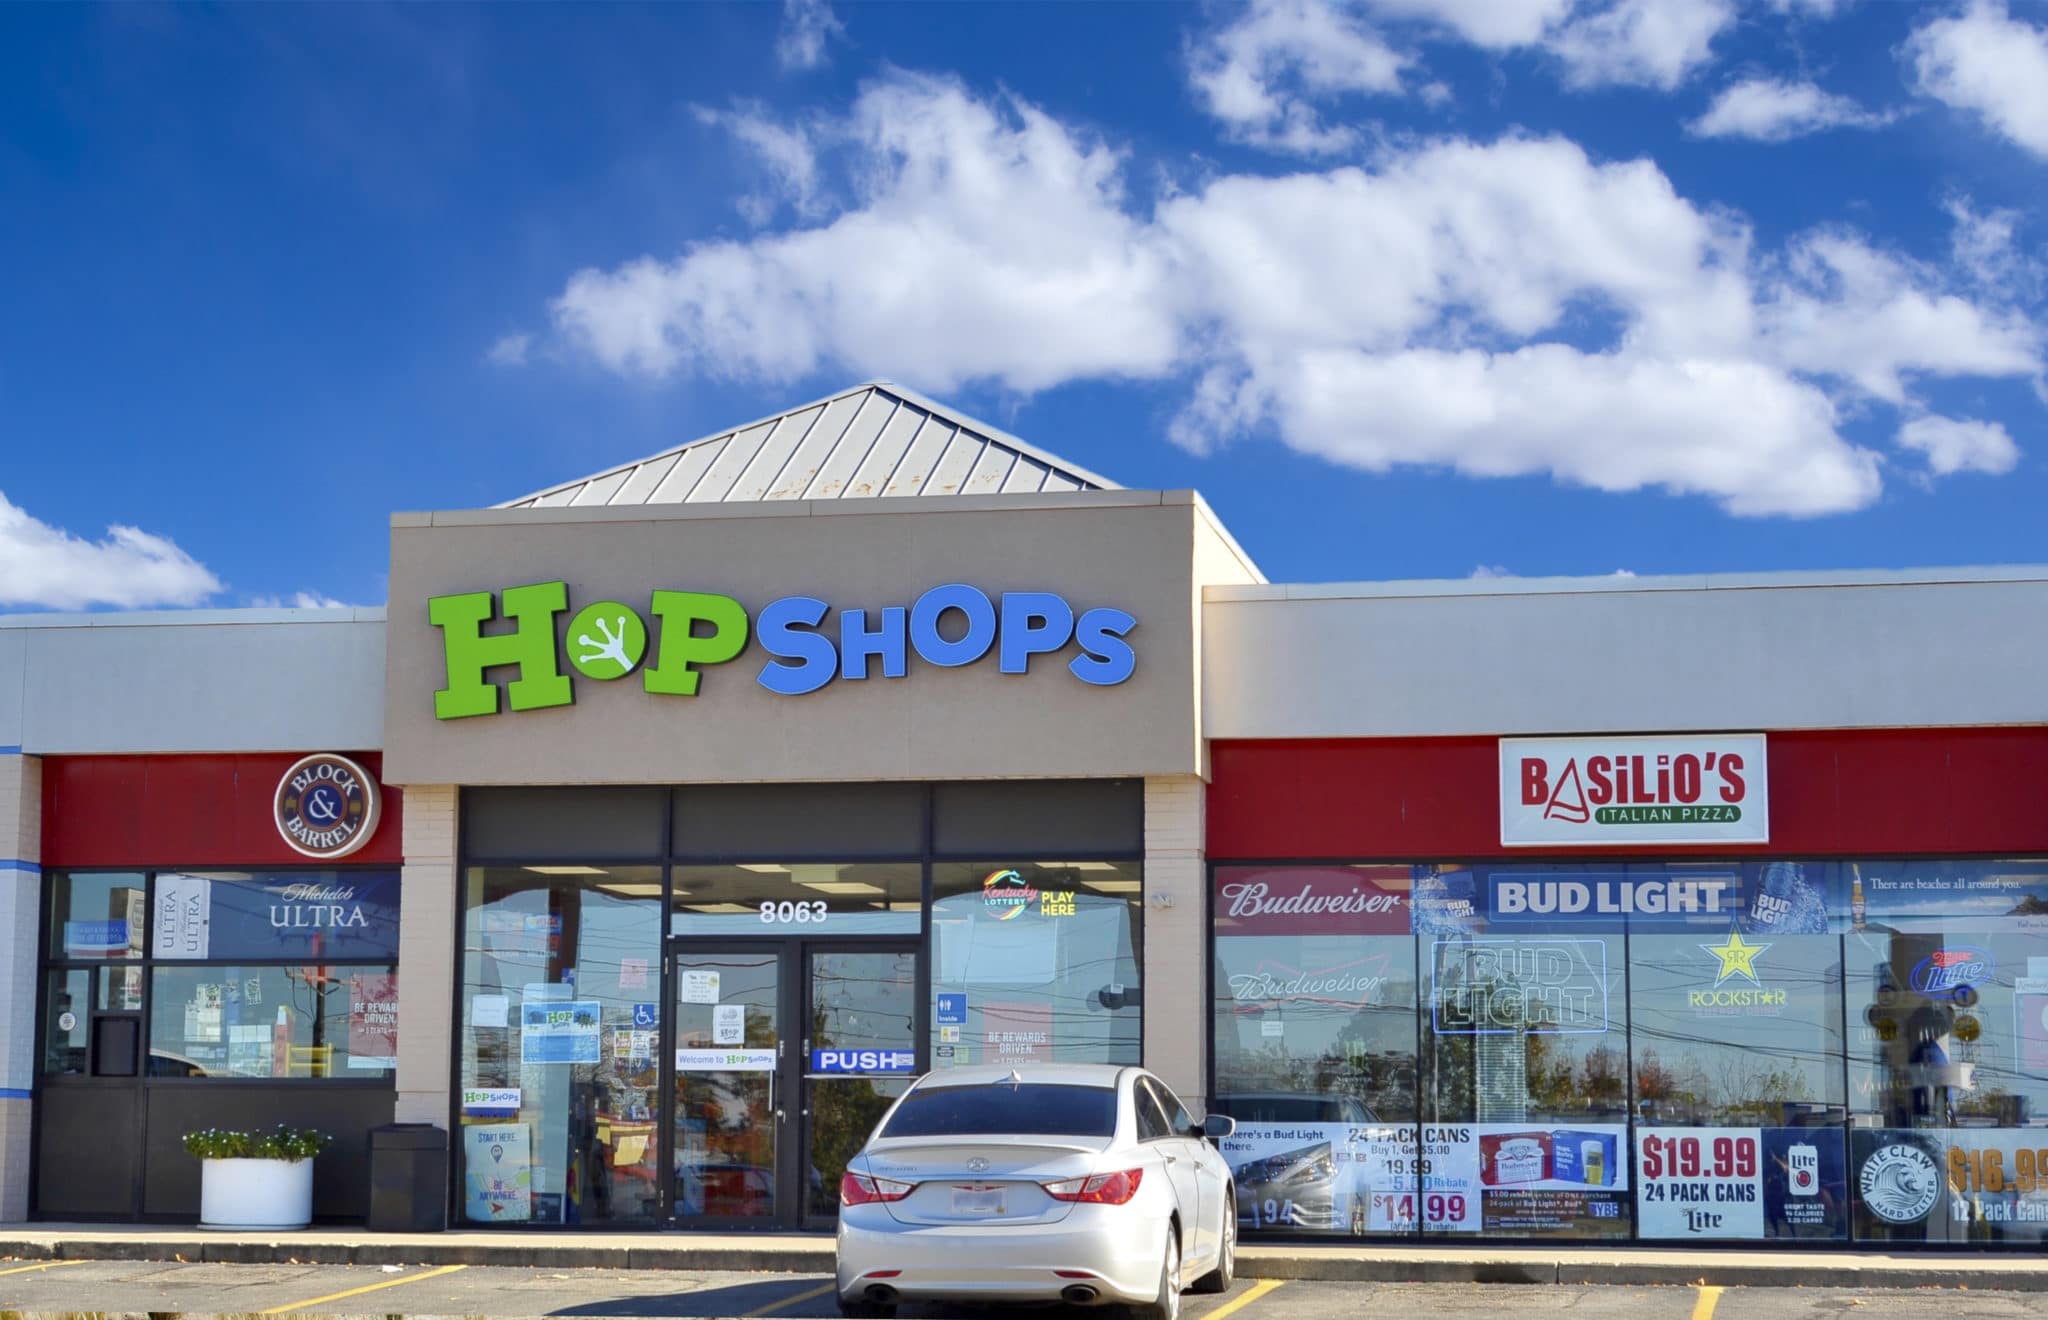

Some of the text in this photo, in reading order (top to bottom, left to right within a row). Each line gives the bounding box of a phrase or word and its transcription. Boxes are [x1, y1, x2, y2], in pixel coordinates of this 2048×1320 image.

[428, 581, 750, 720] HOP
[291, 763, 360, 797] BLOCK
[308, 788, 339, 820] &
[1602, 807, 1735, 821] ITALIAN PIZZA
[287, 814, 359, 848] BARREL
[282, 883, 355, 902] Michelob
[983, 885, 1038, 903] Kentucky
[1870, 878, 2022, 893] There are beaches all around you.
[984, 898, 1026, 906] LOTTERY
[1041, 891, 1075, 903] PLAY
[1222, 882, 1400, 917] Budweiser
[1497, 882, 1726, 913] BUD LIGHT
[1757, 893, 1792, 914] BUD
[163, 890, 176, 949] ULTRA
[270, 905, 369, 927] ULTRA
[760, 901, 827, 923] 8063
[1040, 904, 1076, 916] HERE
[187, 893, 200, 952] ULTRA
[1464, 948, 1574, 985] BUD
[1228, 972, 1387, 1000] Budweiser
[1443, 986, 1595, 1026] LIGHT
[988, 1032, 1047, 1042] BE REWARDS
[680, 1055, 715, 1064] Welcome
[716, 1056, 724, 1064] to
[821, 1052, 897, 1069] PUSH
[1226, 1130, 1262, 1139] here's
[1273, 1130, 1295, 1139] Bud
[1297, 1130, 1324, 1141] Light
[1425, 1128, 1470, 1143] CANS
[1223, 1142, 1255, 1151] there.
[1371, 1145, 1389, 1156] Buy
[1643, 1134, 1756, 1180] $19.99
[1791, 1154, 1816, 1170] Lite
[1861, 1146, 1933, 1195] WHITE CLAW
[1434, 1177, 1468, 1187] Rebate
[1645, 1183, 1756, 1202] 24 PACK CANS
[1874, 1180, 1936, 1218] HARD SELTZER
[1686, 1208, 1722, 1233] Lite
[1953, 1200, 1970, 1222] 12
[1975, 1200, 2012, 1222] Pack
